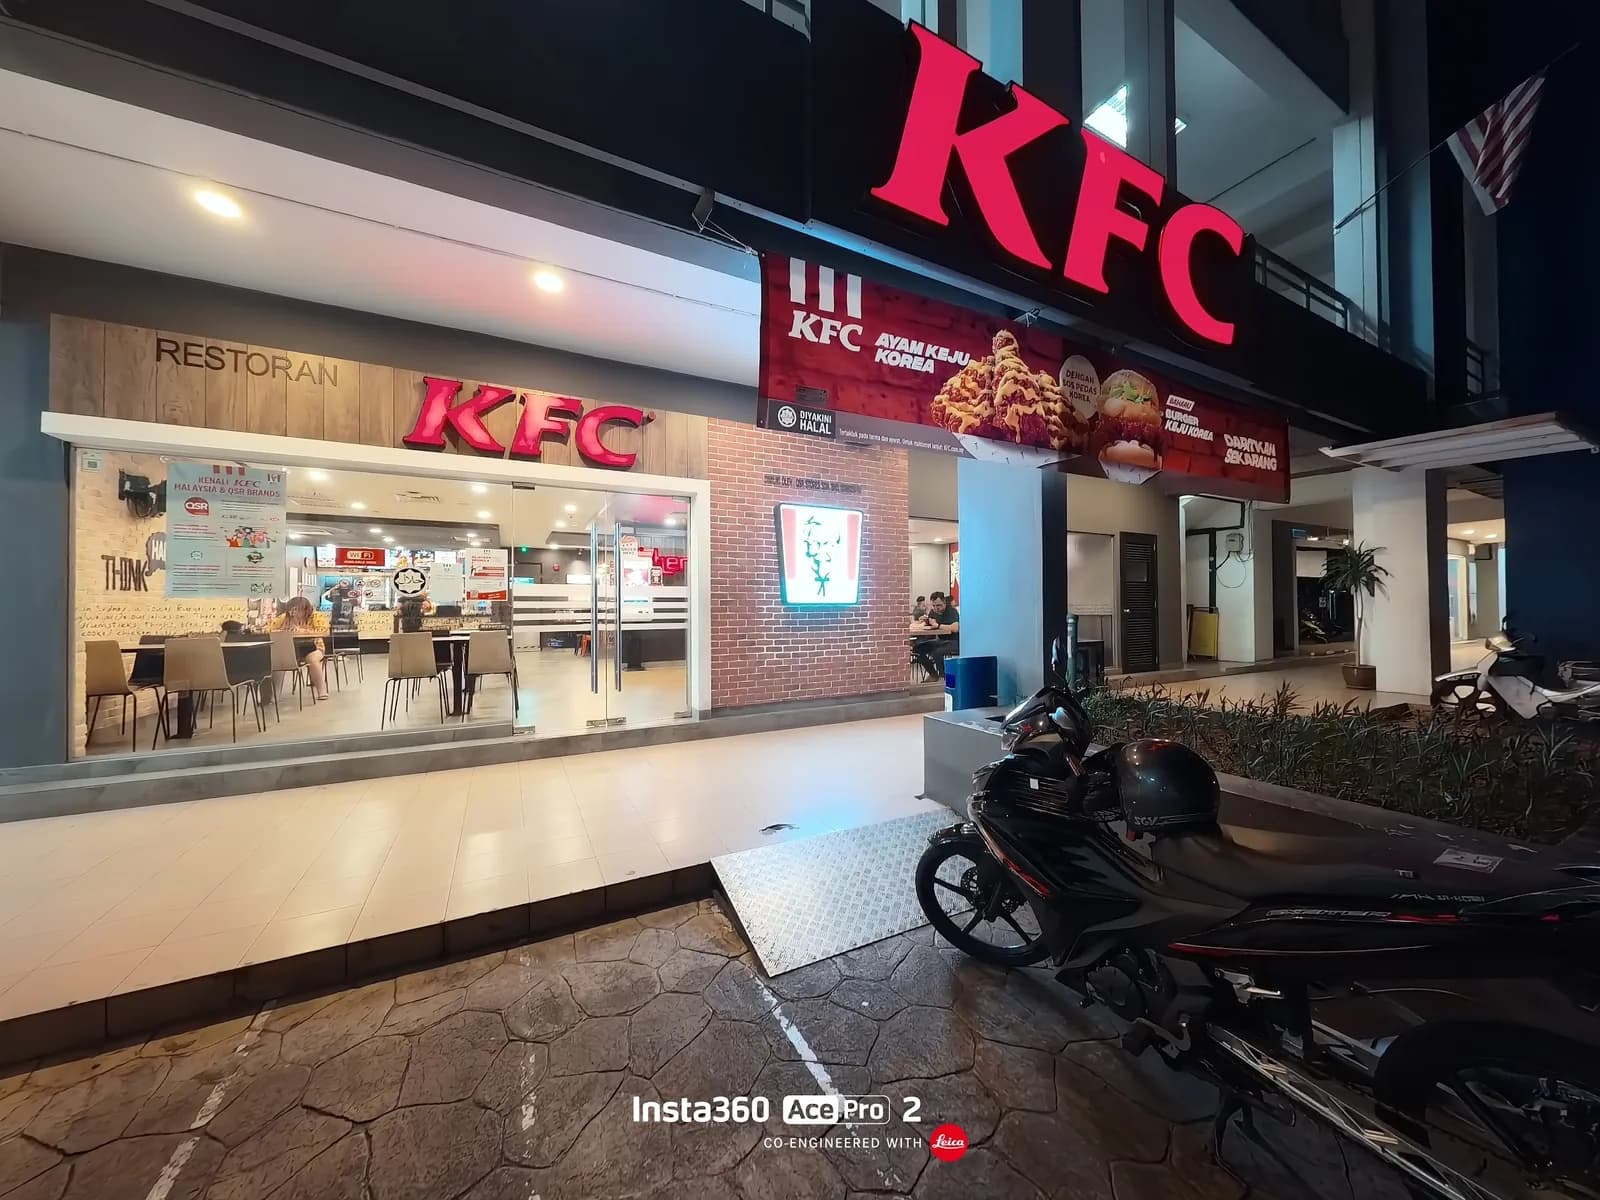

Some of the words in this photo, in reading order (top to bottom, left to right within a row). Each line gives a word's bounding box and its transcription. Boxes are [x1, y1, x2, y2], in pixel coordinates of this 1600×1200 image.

[870, 21, 1245, 345] KFC
[788, 310, 864, 352] KFC
[875, 333, 925, 356] AYAM
[925, 343, 971, 367] KEJU
[875, 348, 935, 374] KOREA
[155, 337, 339, 387] RESTORAN
[1066, 369, 1095, 385] DENGAN
[1075, 382, 1097, 395] PEDAS
[1069, 390, 1090, 402] KOREA
[402, 376, 644, 467] KFC
[800, 410, 832, 423] DIYAKINI
[800, 419, 832, 435] HALAL
[1165, 408, 1199, 427] BURGER
[1164, 419, 1189, 435] KEJU
[1187, 425, 1215, 442] KOREA
[1224, 448, 1277, 471] SEKARANG
[174, 483, 217, 493] MALAYSIA
[227, 487, 245, 496] QSR
[247, 488, 280, 498] BRANDS
[185, 501, 208, 511] QSR
[101, 554, 148, 592] THINK
